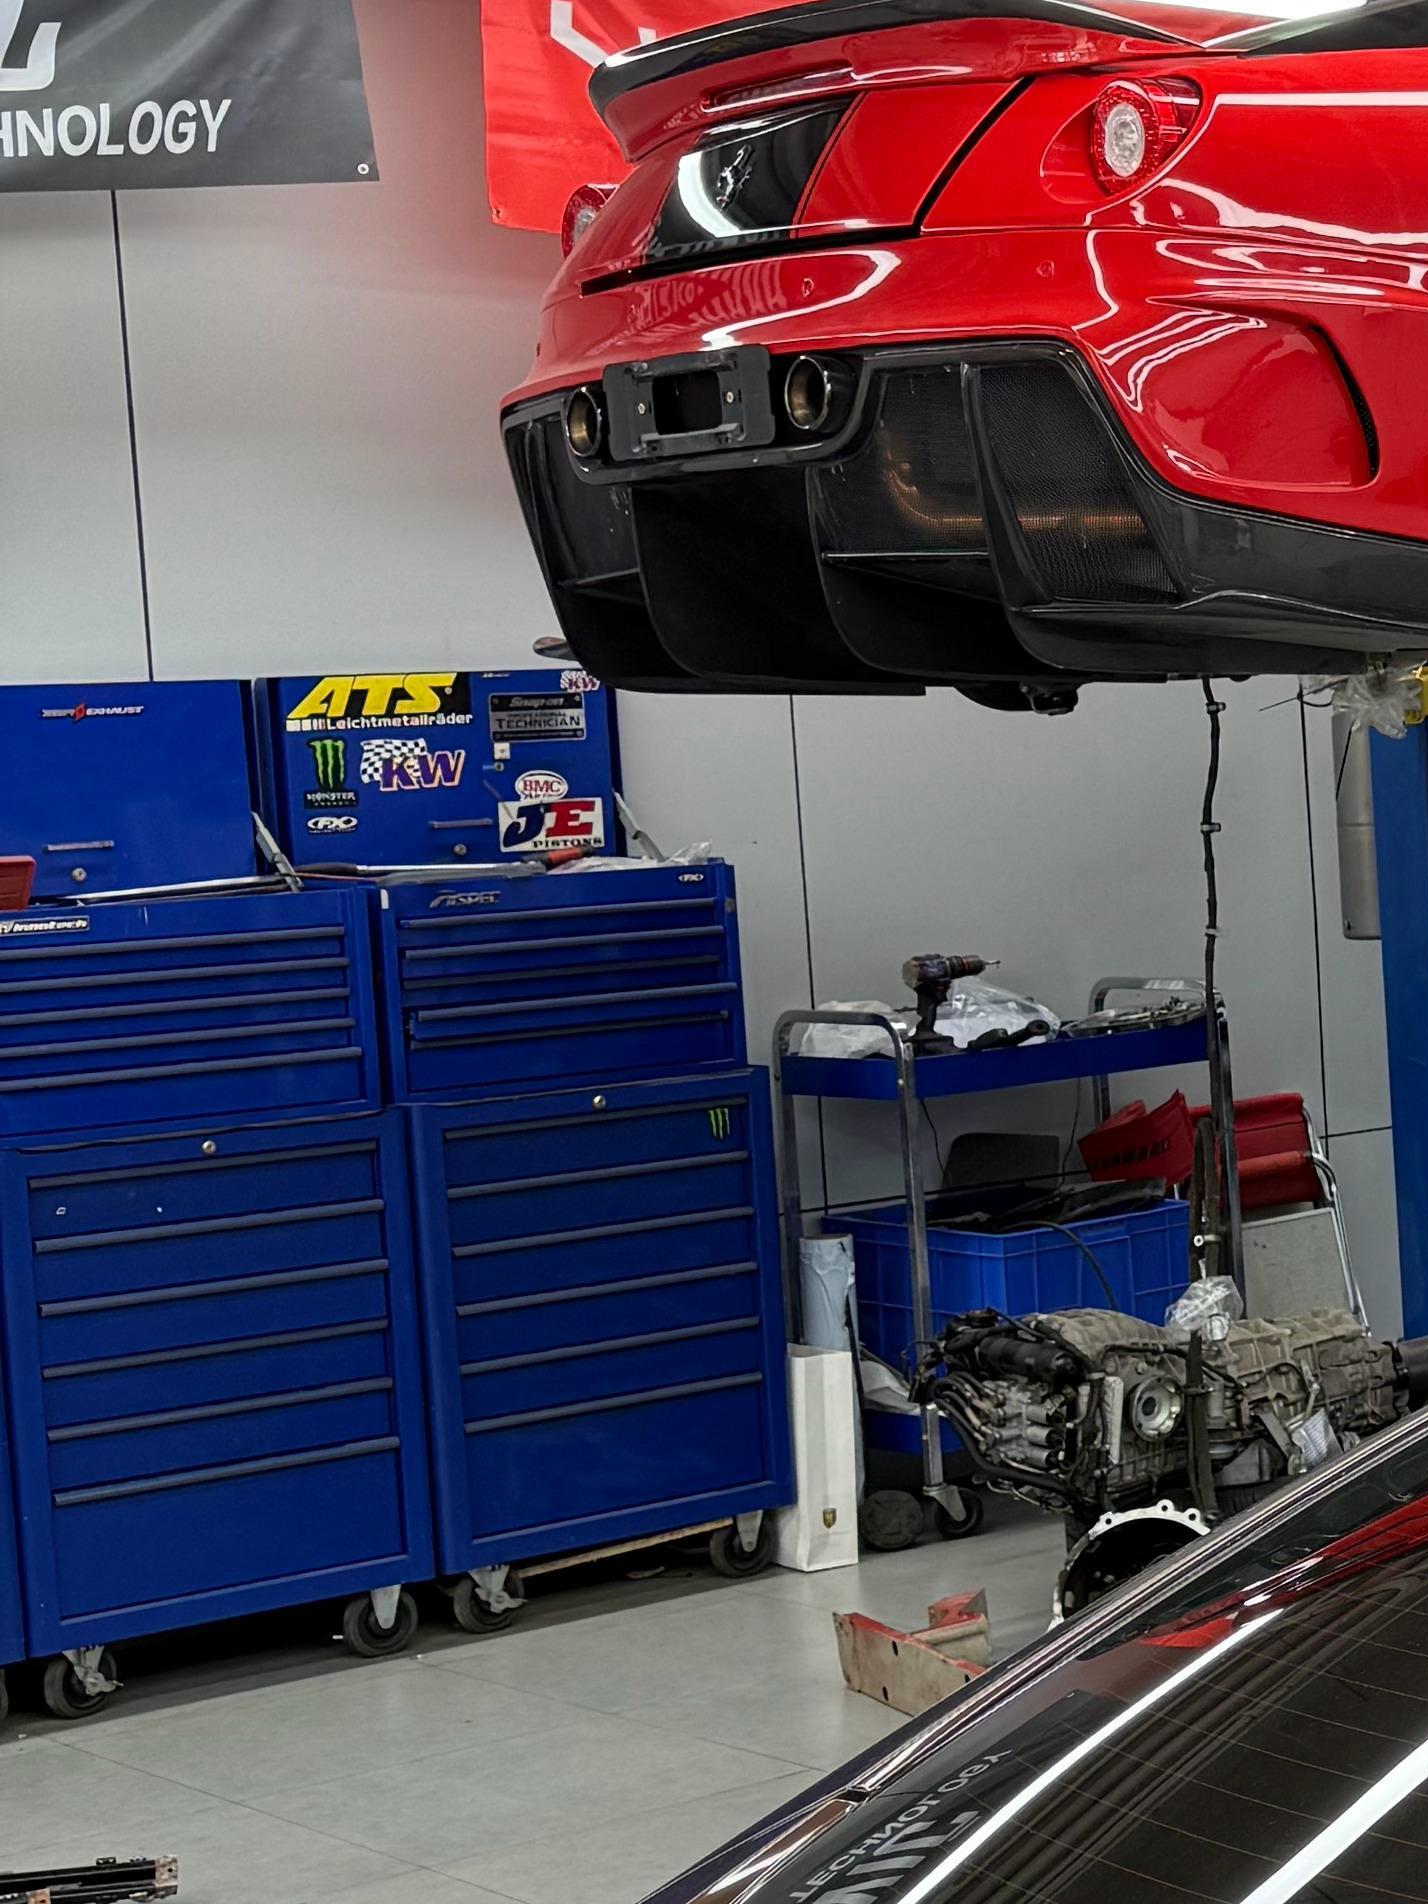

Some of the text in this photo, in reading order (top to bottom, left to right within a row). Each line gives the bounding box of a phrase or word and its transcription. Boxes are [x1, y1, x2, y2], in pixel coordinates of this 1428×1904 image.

[568, 675, 600, 693] KW
[286, 672, 457, 719] ATS
[509, 697, 564, 709] Snap-on
[327, 713, 474, 731] Leichtmetallräder
[496, 716, 581, 730] TECHNICIAN
[380, 748, 466, 793] KW
[522, 779, 562, 794] BMC
[503, 800, 596, 848] JE
[531, 837, 602, 849] PISTONS
